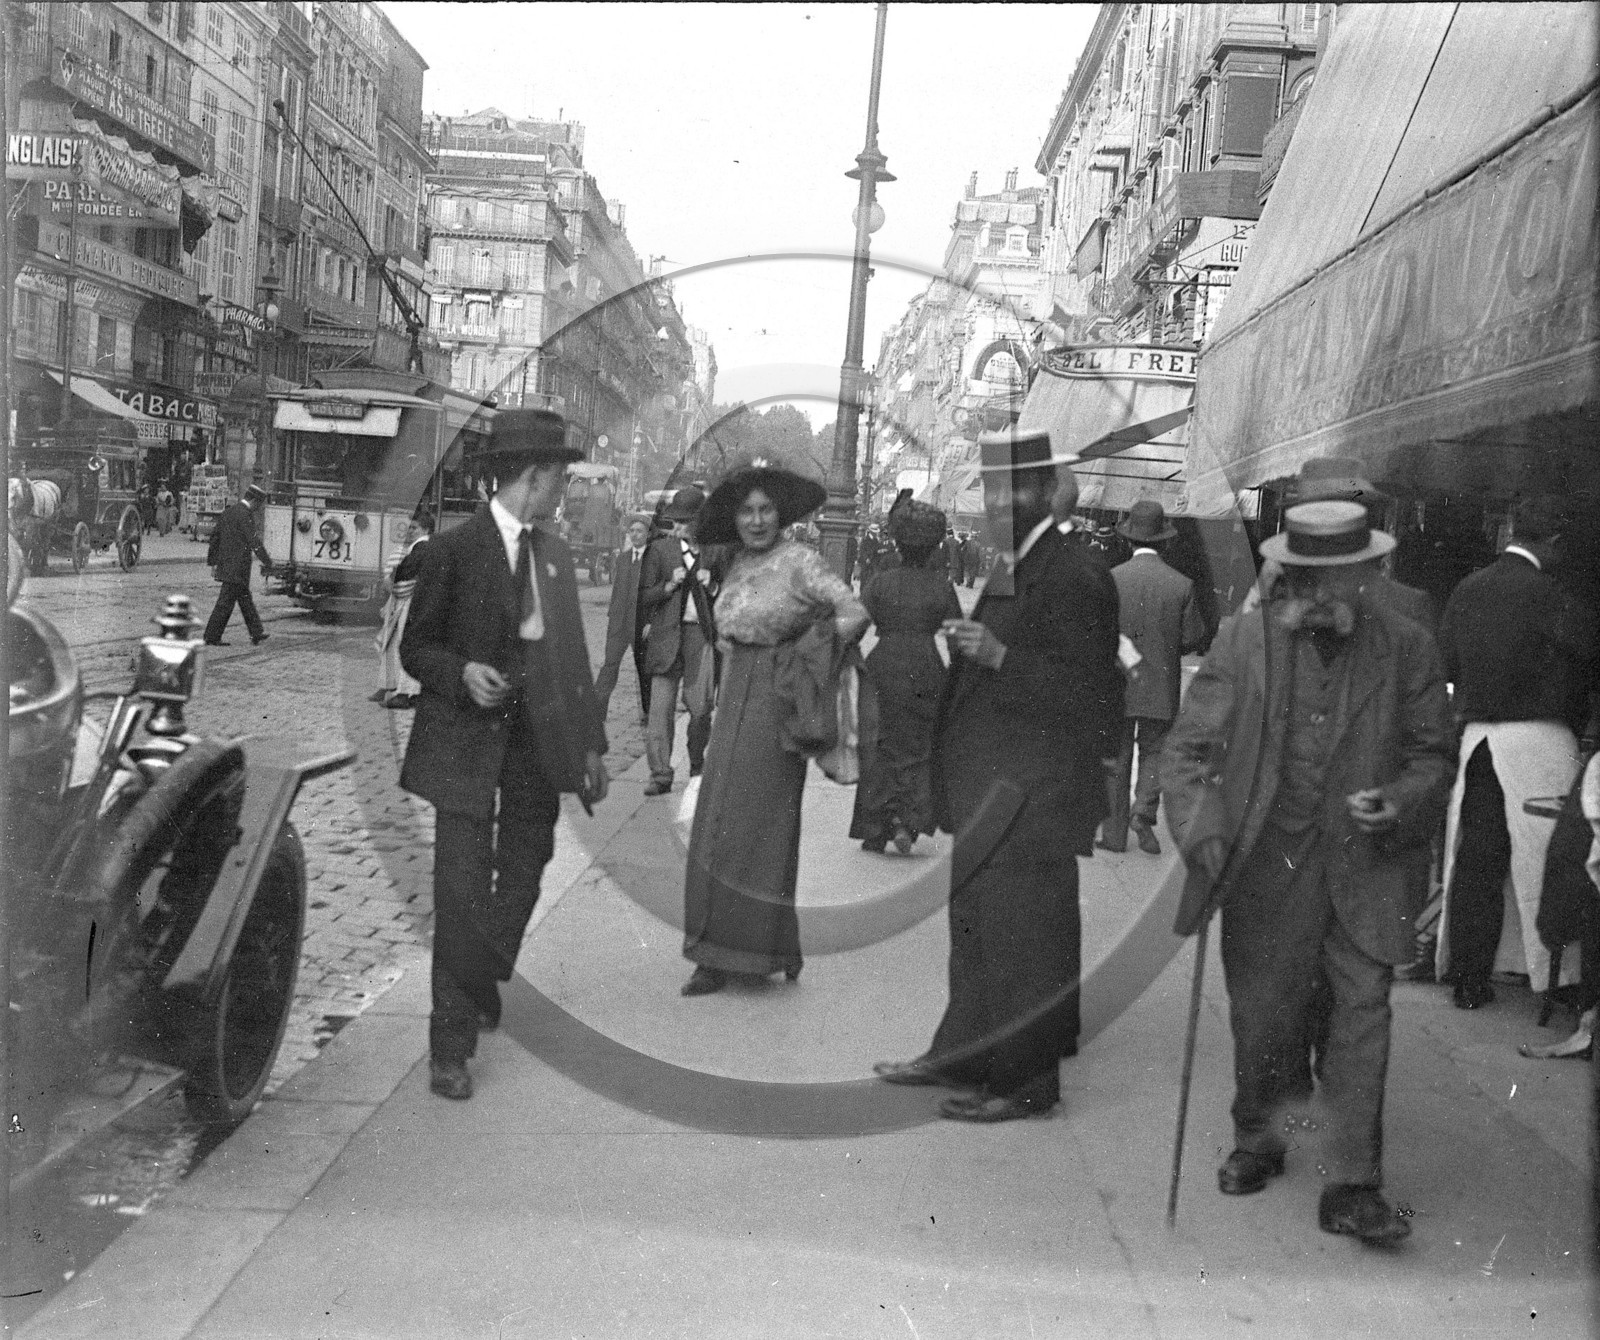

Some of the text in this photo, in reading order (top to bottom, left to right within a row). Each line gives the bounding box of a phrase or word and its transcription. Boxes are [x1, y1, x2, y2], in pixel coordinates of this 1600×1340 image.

[109, 88, 124, 119] AS
[225, 307, 273, 332] PHARMAC
[116, 388, 194, 420] TABAC
[314, 540, 351, 560] 781
